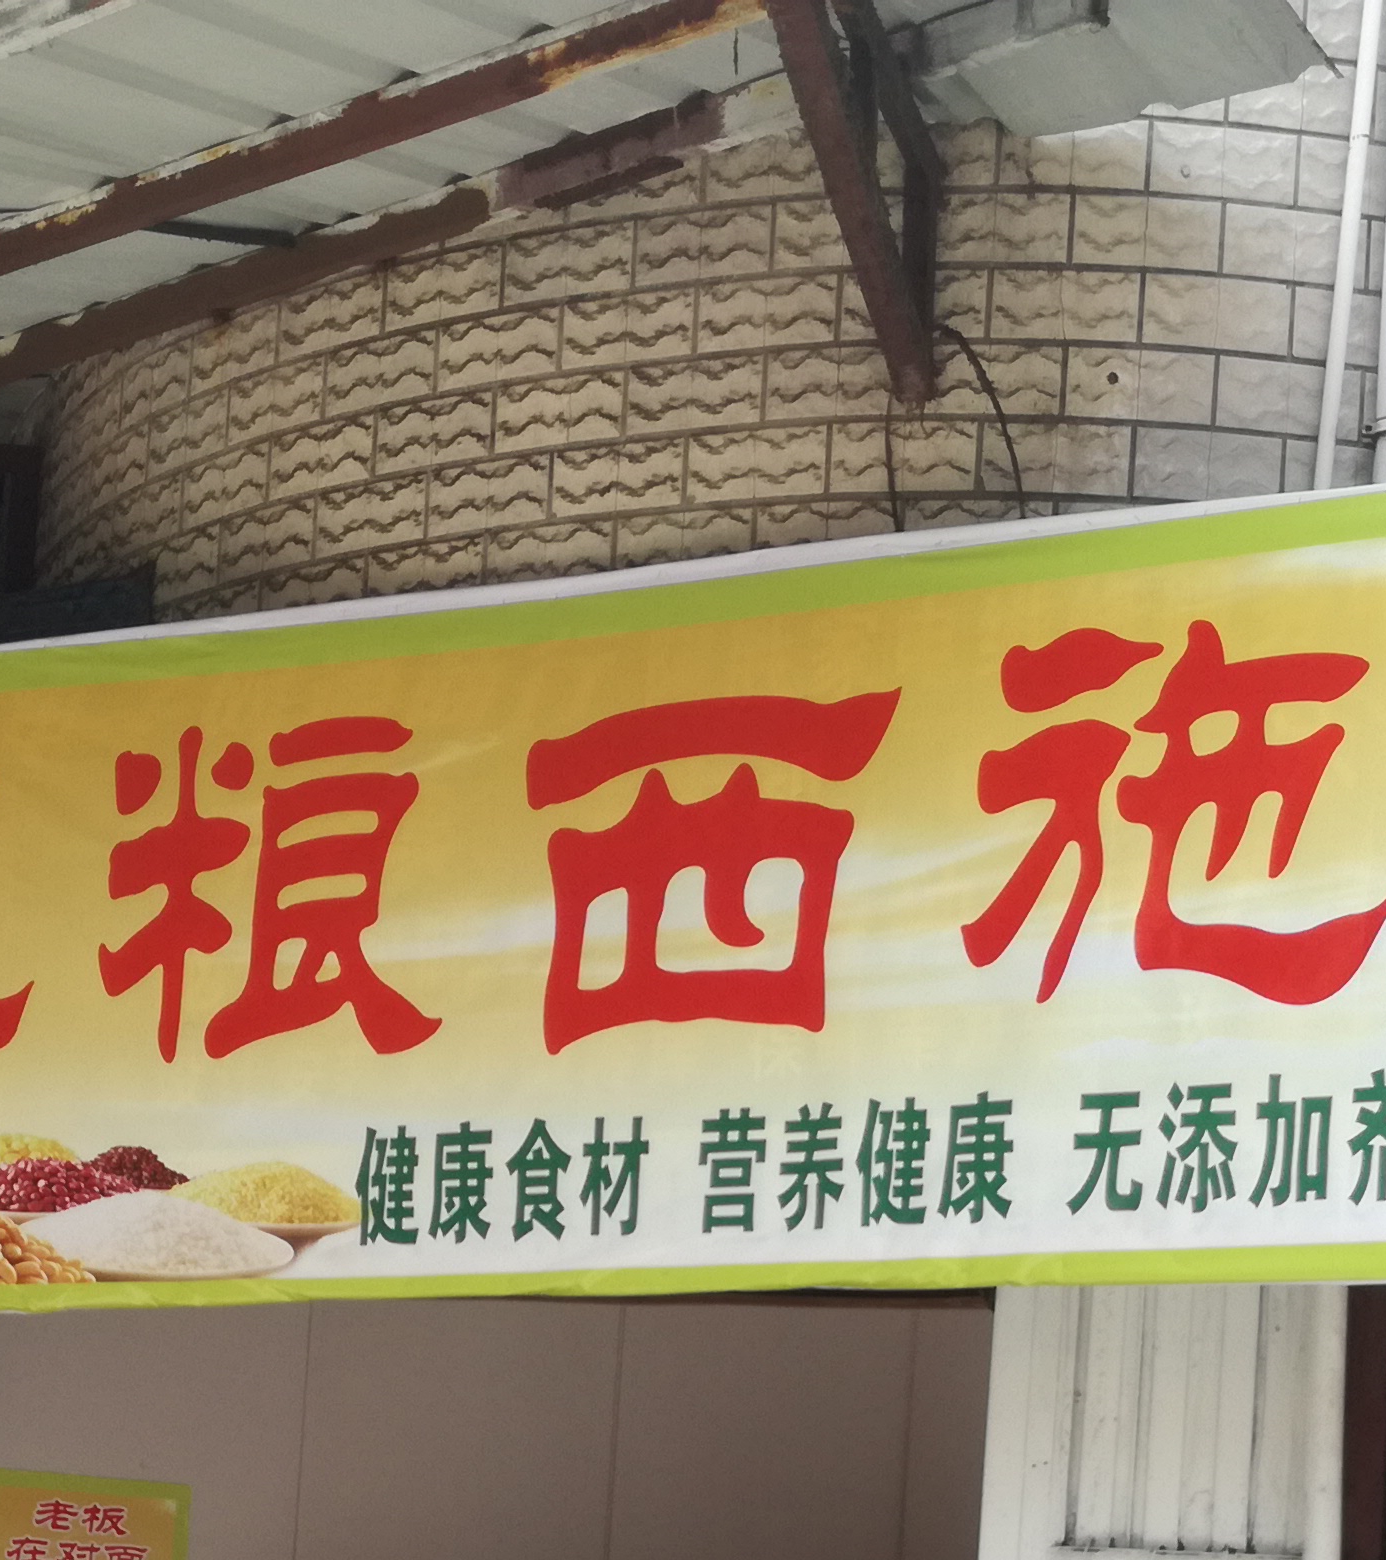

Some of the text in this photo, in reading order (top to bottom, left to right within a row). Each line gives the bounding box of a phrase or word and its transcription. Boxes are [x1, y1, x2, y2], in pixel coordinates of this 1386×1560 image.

[354, 1111, 653, 1250] 健康食材
[699, 1090, 1015, 1235] 营养健康
[35, 1500, 127, 1535] 老板
